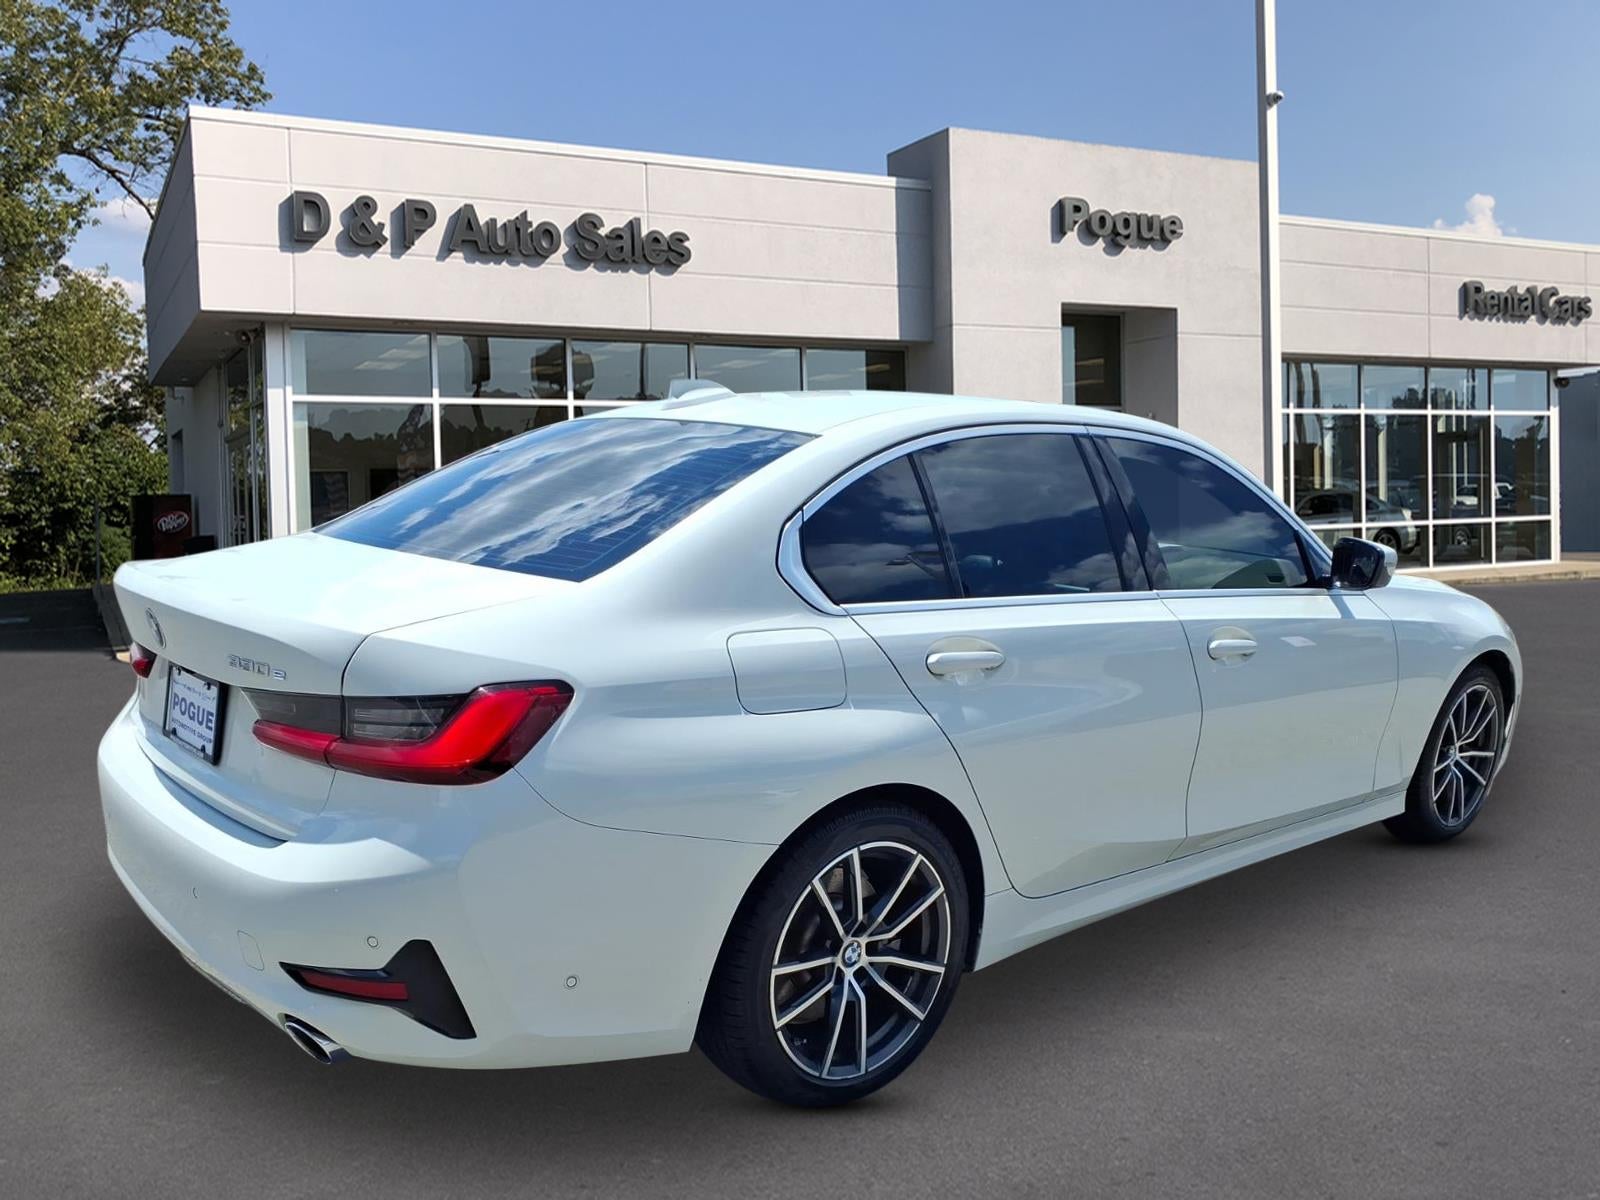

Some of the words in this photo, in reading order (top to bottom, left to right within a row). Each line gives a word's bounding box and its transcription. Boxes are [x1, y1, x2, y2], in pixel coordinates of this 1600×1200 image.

[287, 190, 331, 247] D
[342, 195, 388, 254] &
[396, 198, 436, 255] P
[444, 203, 562, 262] Auto
[567, 212, 692, 271] Sales
[1057, 197, 1183, 251] Pogue
[1461, 280, 1537, 321] Rental
[1536, 286, 1592, 324] Cars
[172, 692, 215, 732] POGUE
